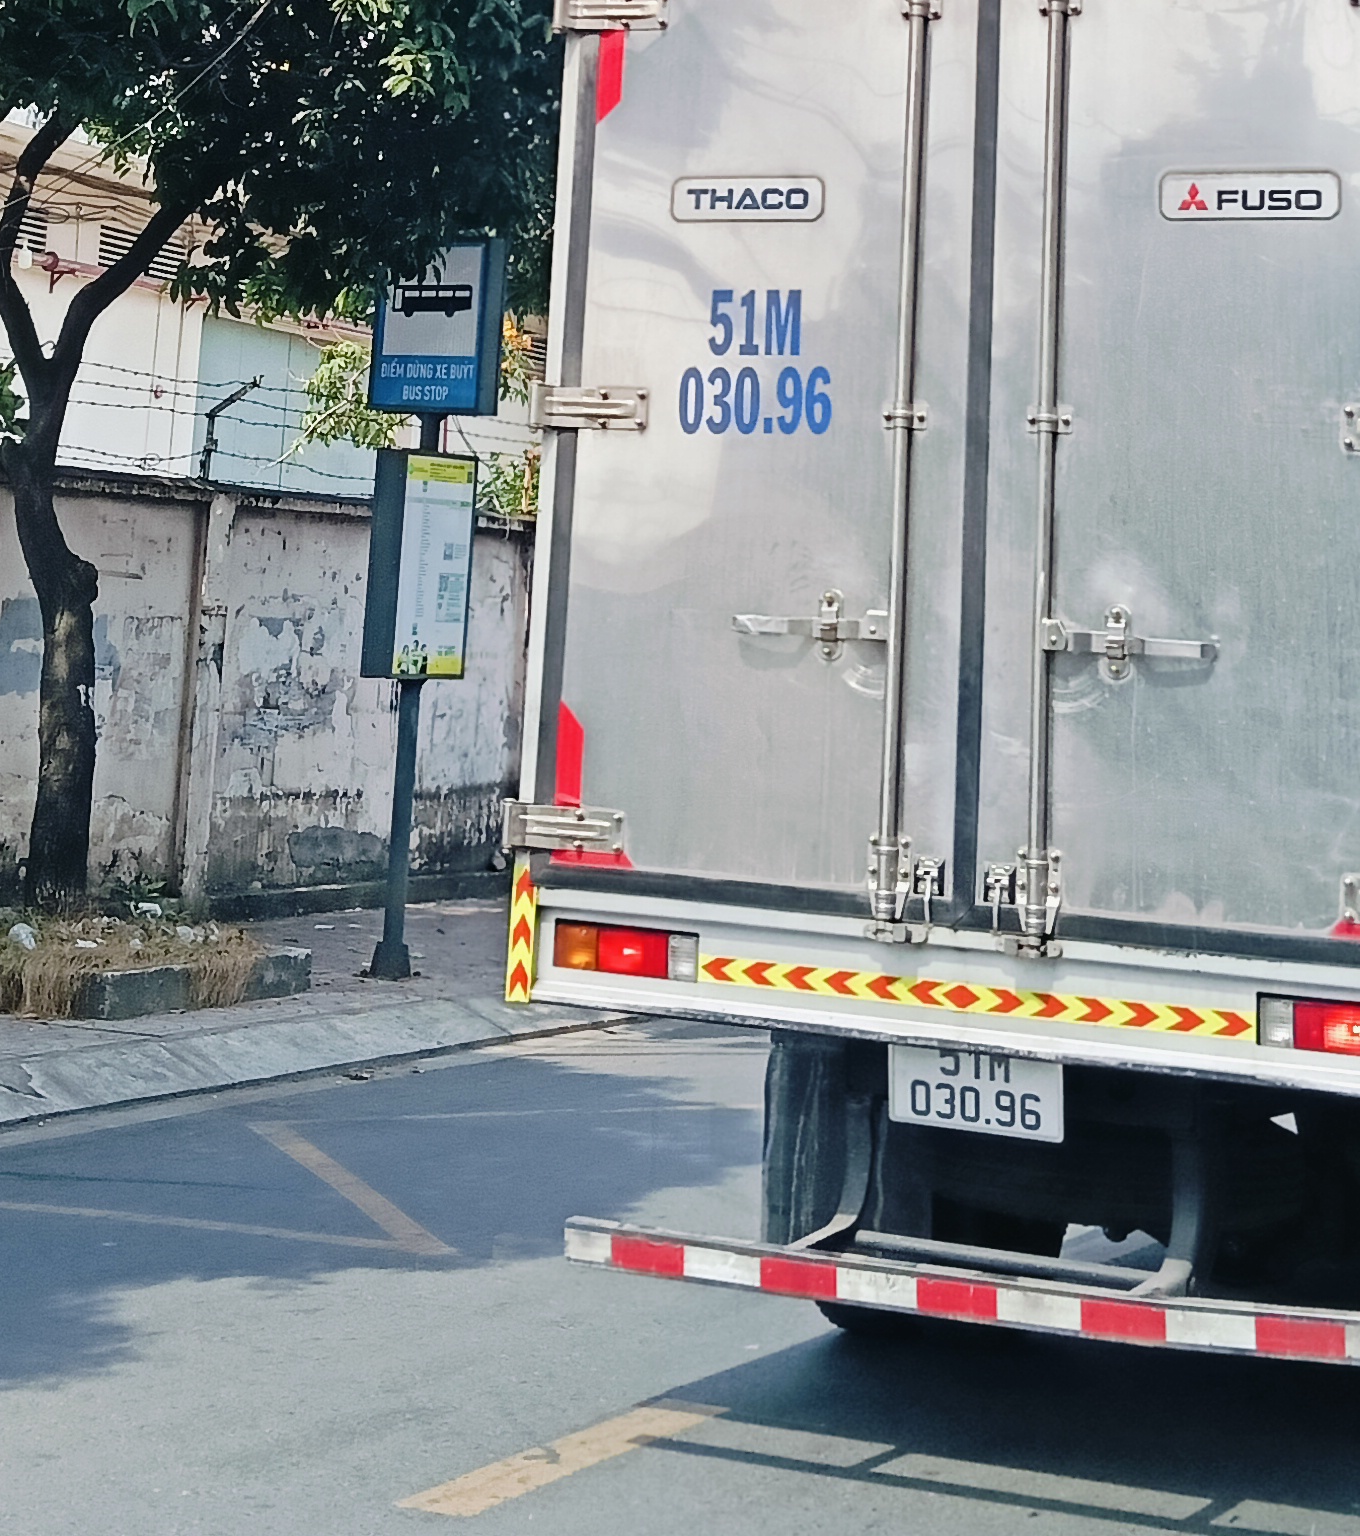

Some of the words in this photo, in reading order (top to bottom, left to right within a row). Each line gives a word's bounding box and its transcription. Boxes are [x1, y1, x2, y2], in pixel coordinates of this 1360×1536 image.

[686, 187, 810, 211] THACO
[1216, 189, 1323, 211] FUSO
[707, 289, 802, 356] 51M
[435, 364, 448, 379] XE
[402, 385, 422, 400] BUS
[423, 386, 449, 401] STOP
[678, 366, 833, 435] 030.96
[939, 1050, 1011, 1084] 51M
[910, 1078, 1042, 1131] 030.96
